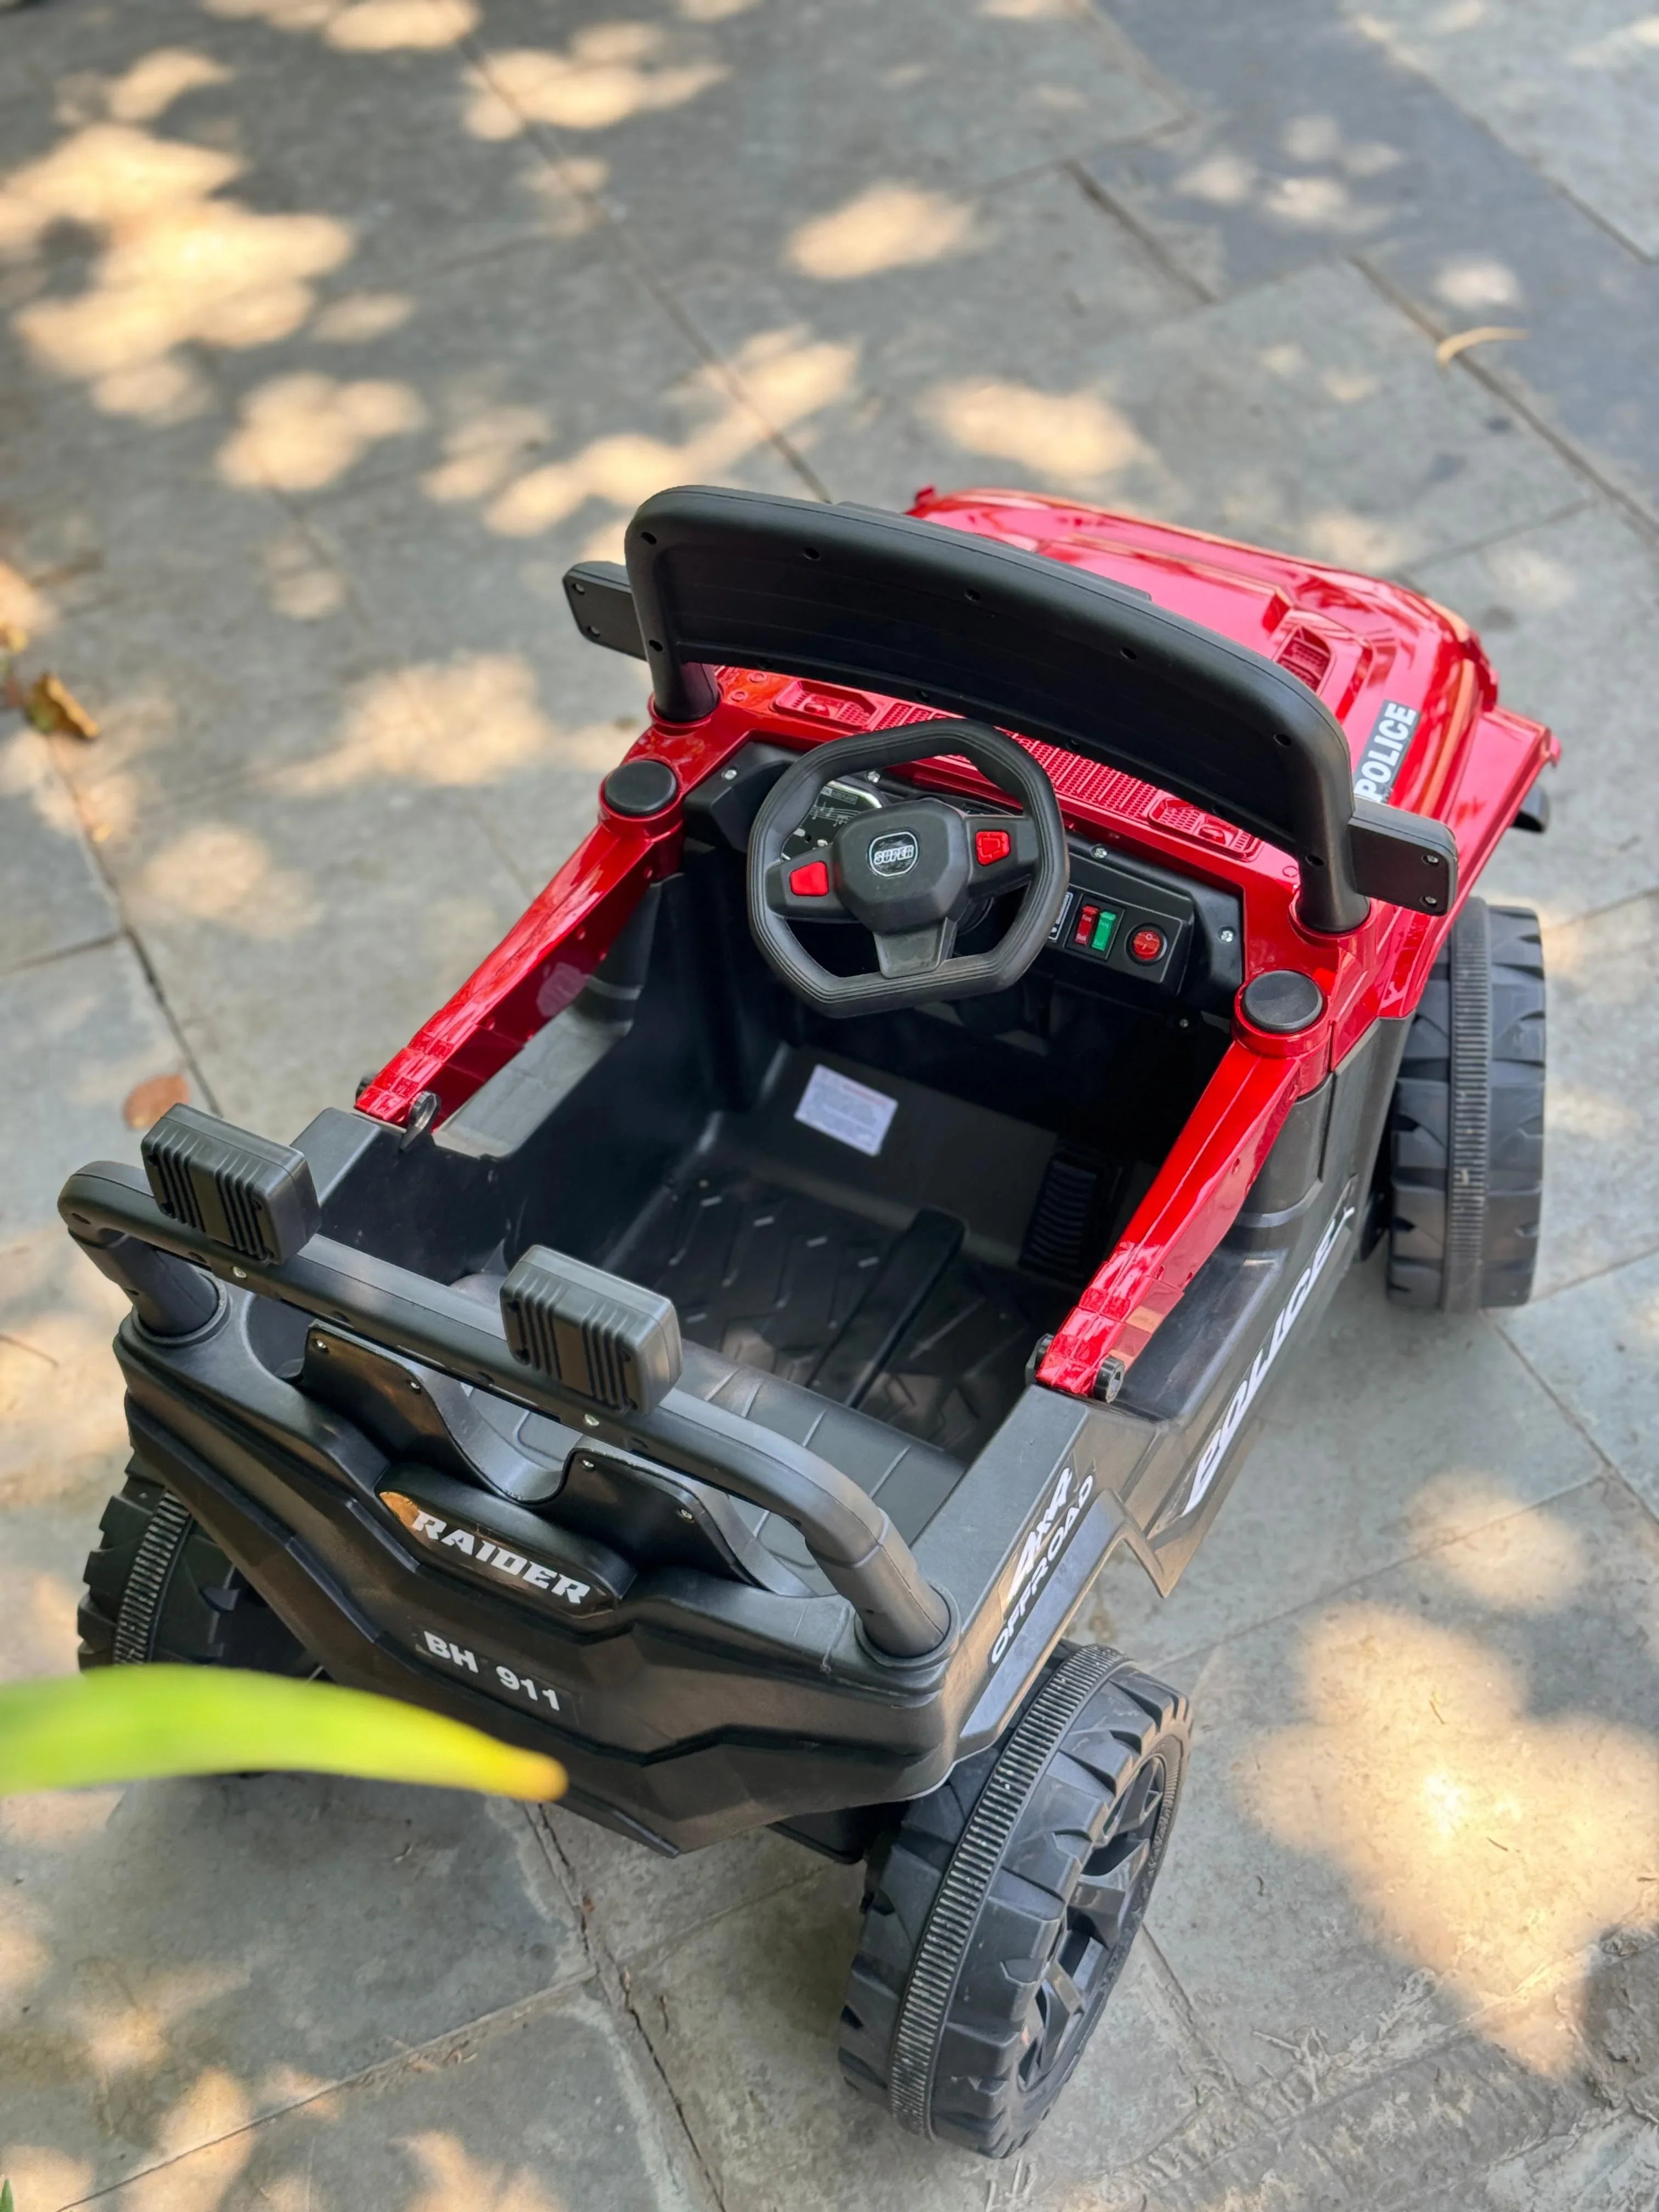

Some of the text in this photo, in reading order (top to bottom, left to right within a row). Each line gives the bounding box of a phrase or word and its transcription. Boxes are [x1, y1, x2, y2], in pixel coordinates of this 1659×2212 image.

[1354, 703, 1416, 803] POLICE
[874, 844, 915, 865] SUPER
[1181, 1207, 1355, 1517] POLICE
[413, 1510, 591, 1605] RAIDER
[423, 1630, 560, 1711] BH 911
